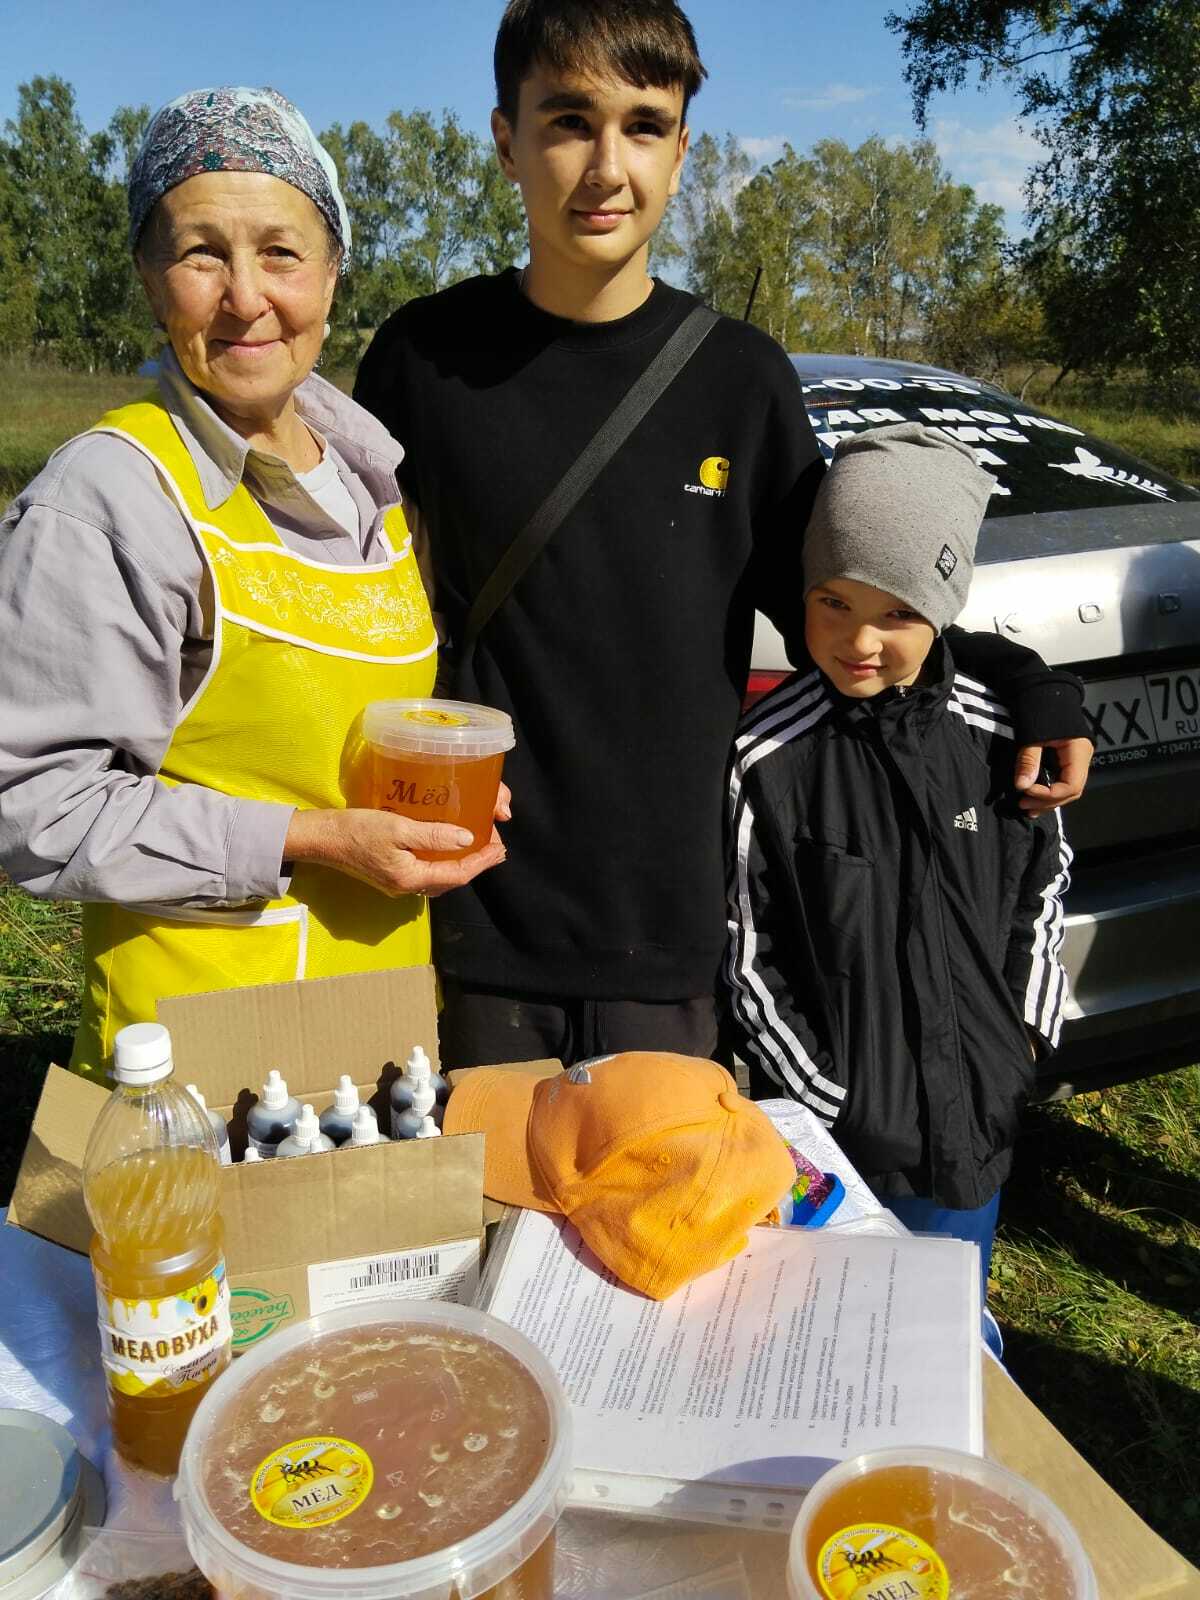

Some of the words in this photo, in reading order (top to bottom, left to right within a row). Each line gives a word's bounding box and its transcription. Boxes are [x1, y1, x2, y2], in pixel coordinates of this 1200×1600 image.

[808, 408, 906, 427] АЯ
[1149, 674, 1200, 721] 70
[1176, 718, 1200, 735] RU
[111, 1315, 219, 1363] МЕДОВУХА
[292, 1484, 342, 1512] МЁД
